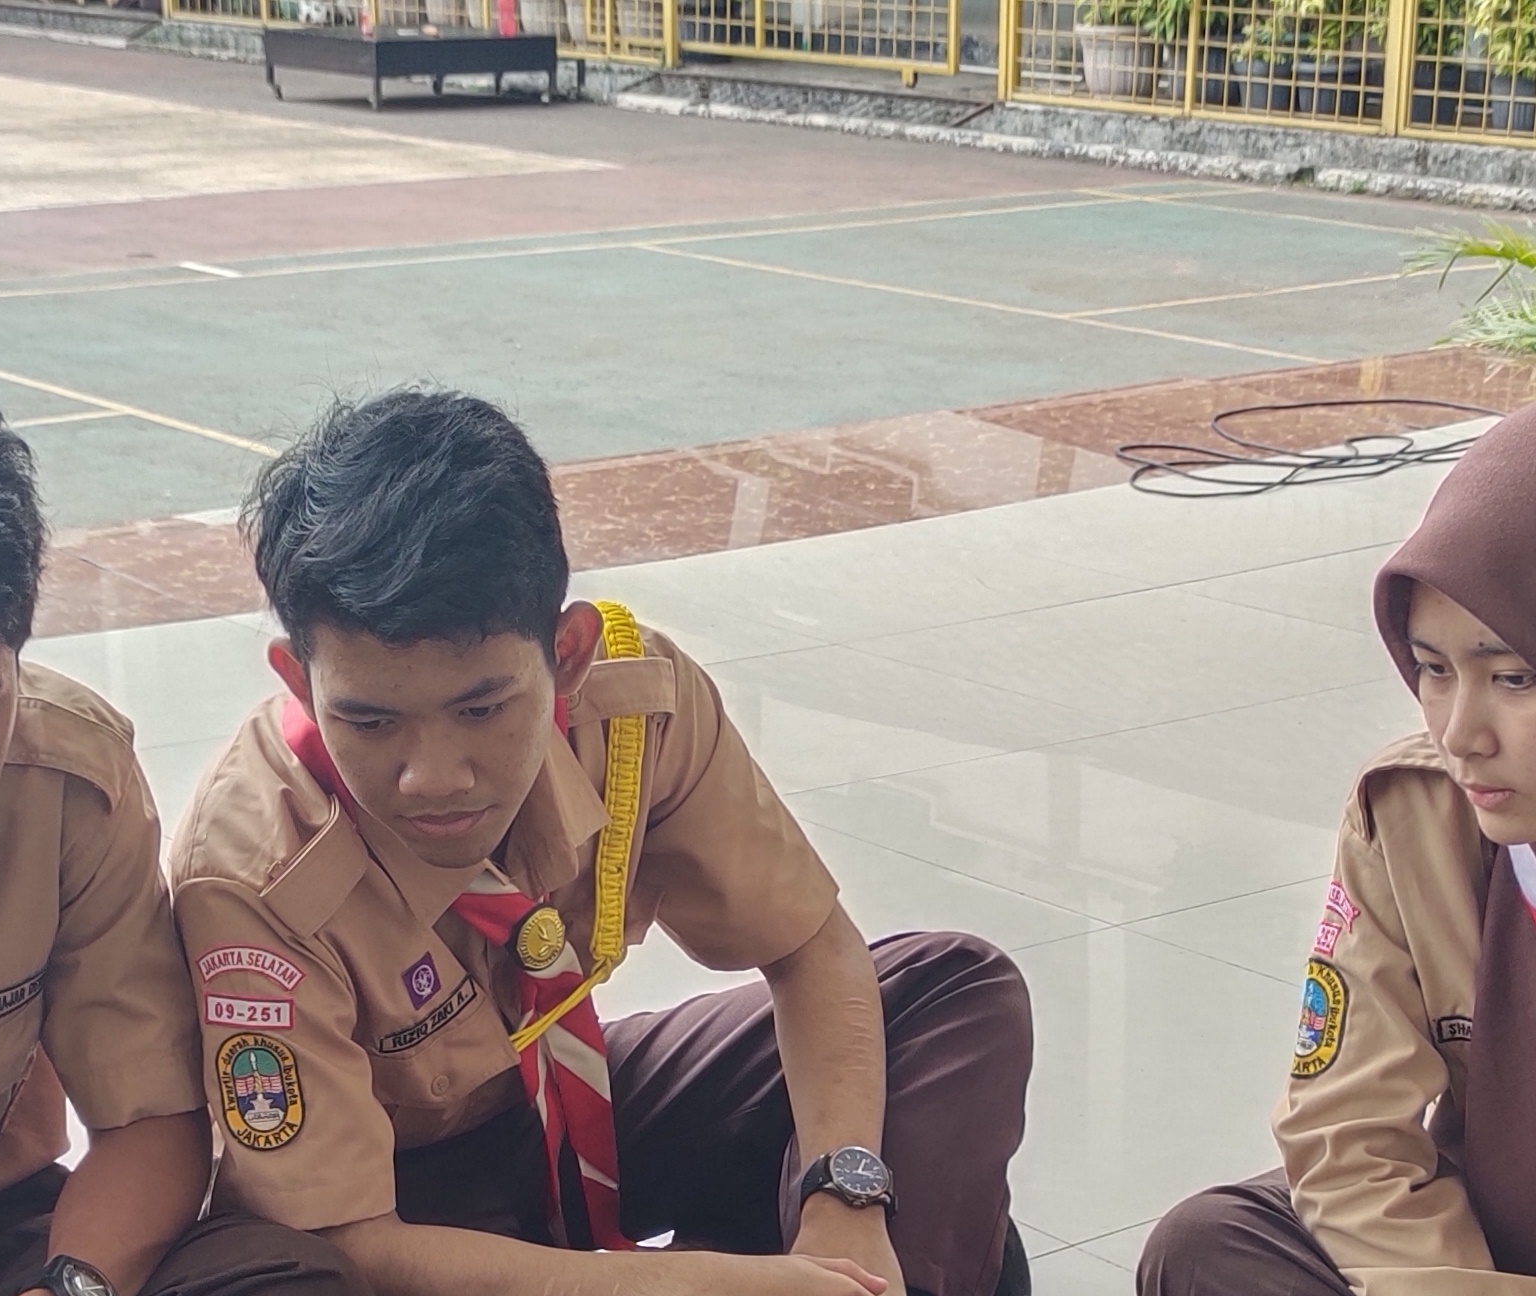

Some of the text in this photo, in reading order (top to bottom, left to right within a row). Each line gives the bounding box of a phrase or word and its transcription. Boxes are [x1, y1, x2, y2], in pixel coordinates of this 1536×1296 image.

[202, 951, 297, 985] JAKARTA SELATAN
[214, 1001, 282, 1023] 09-251
[391, 990, 469, 1048] RIZIQ ZAKI A.
[237, 1121, 298, 1147] JAKARTA
